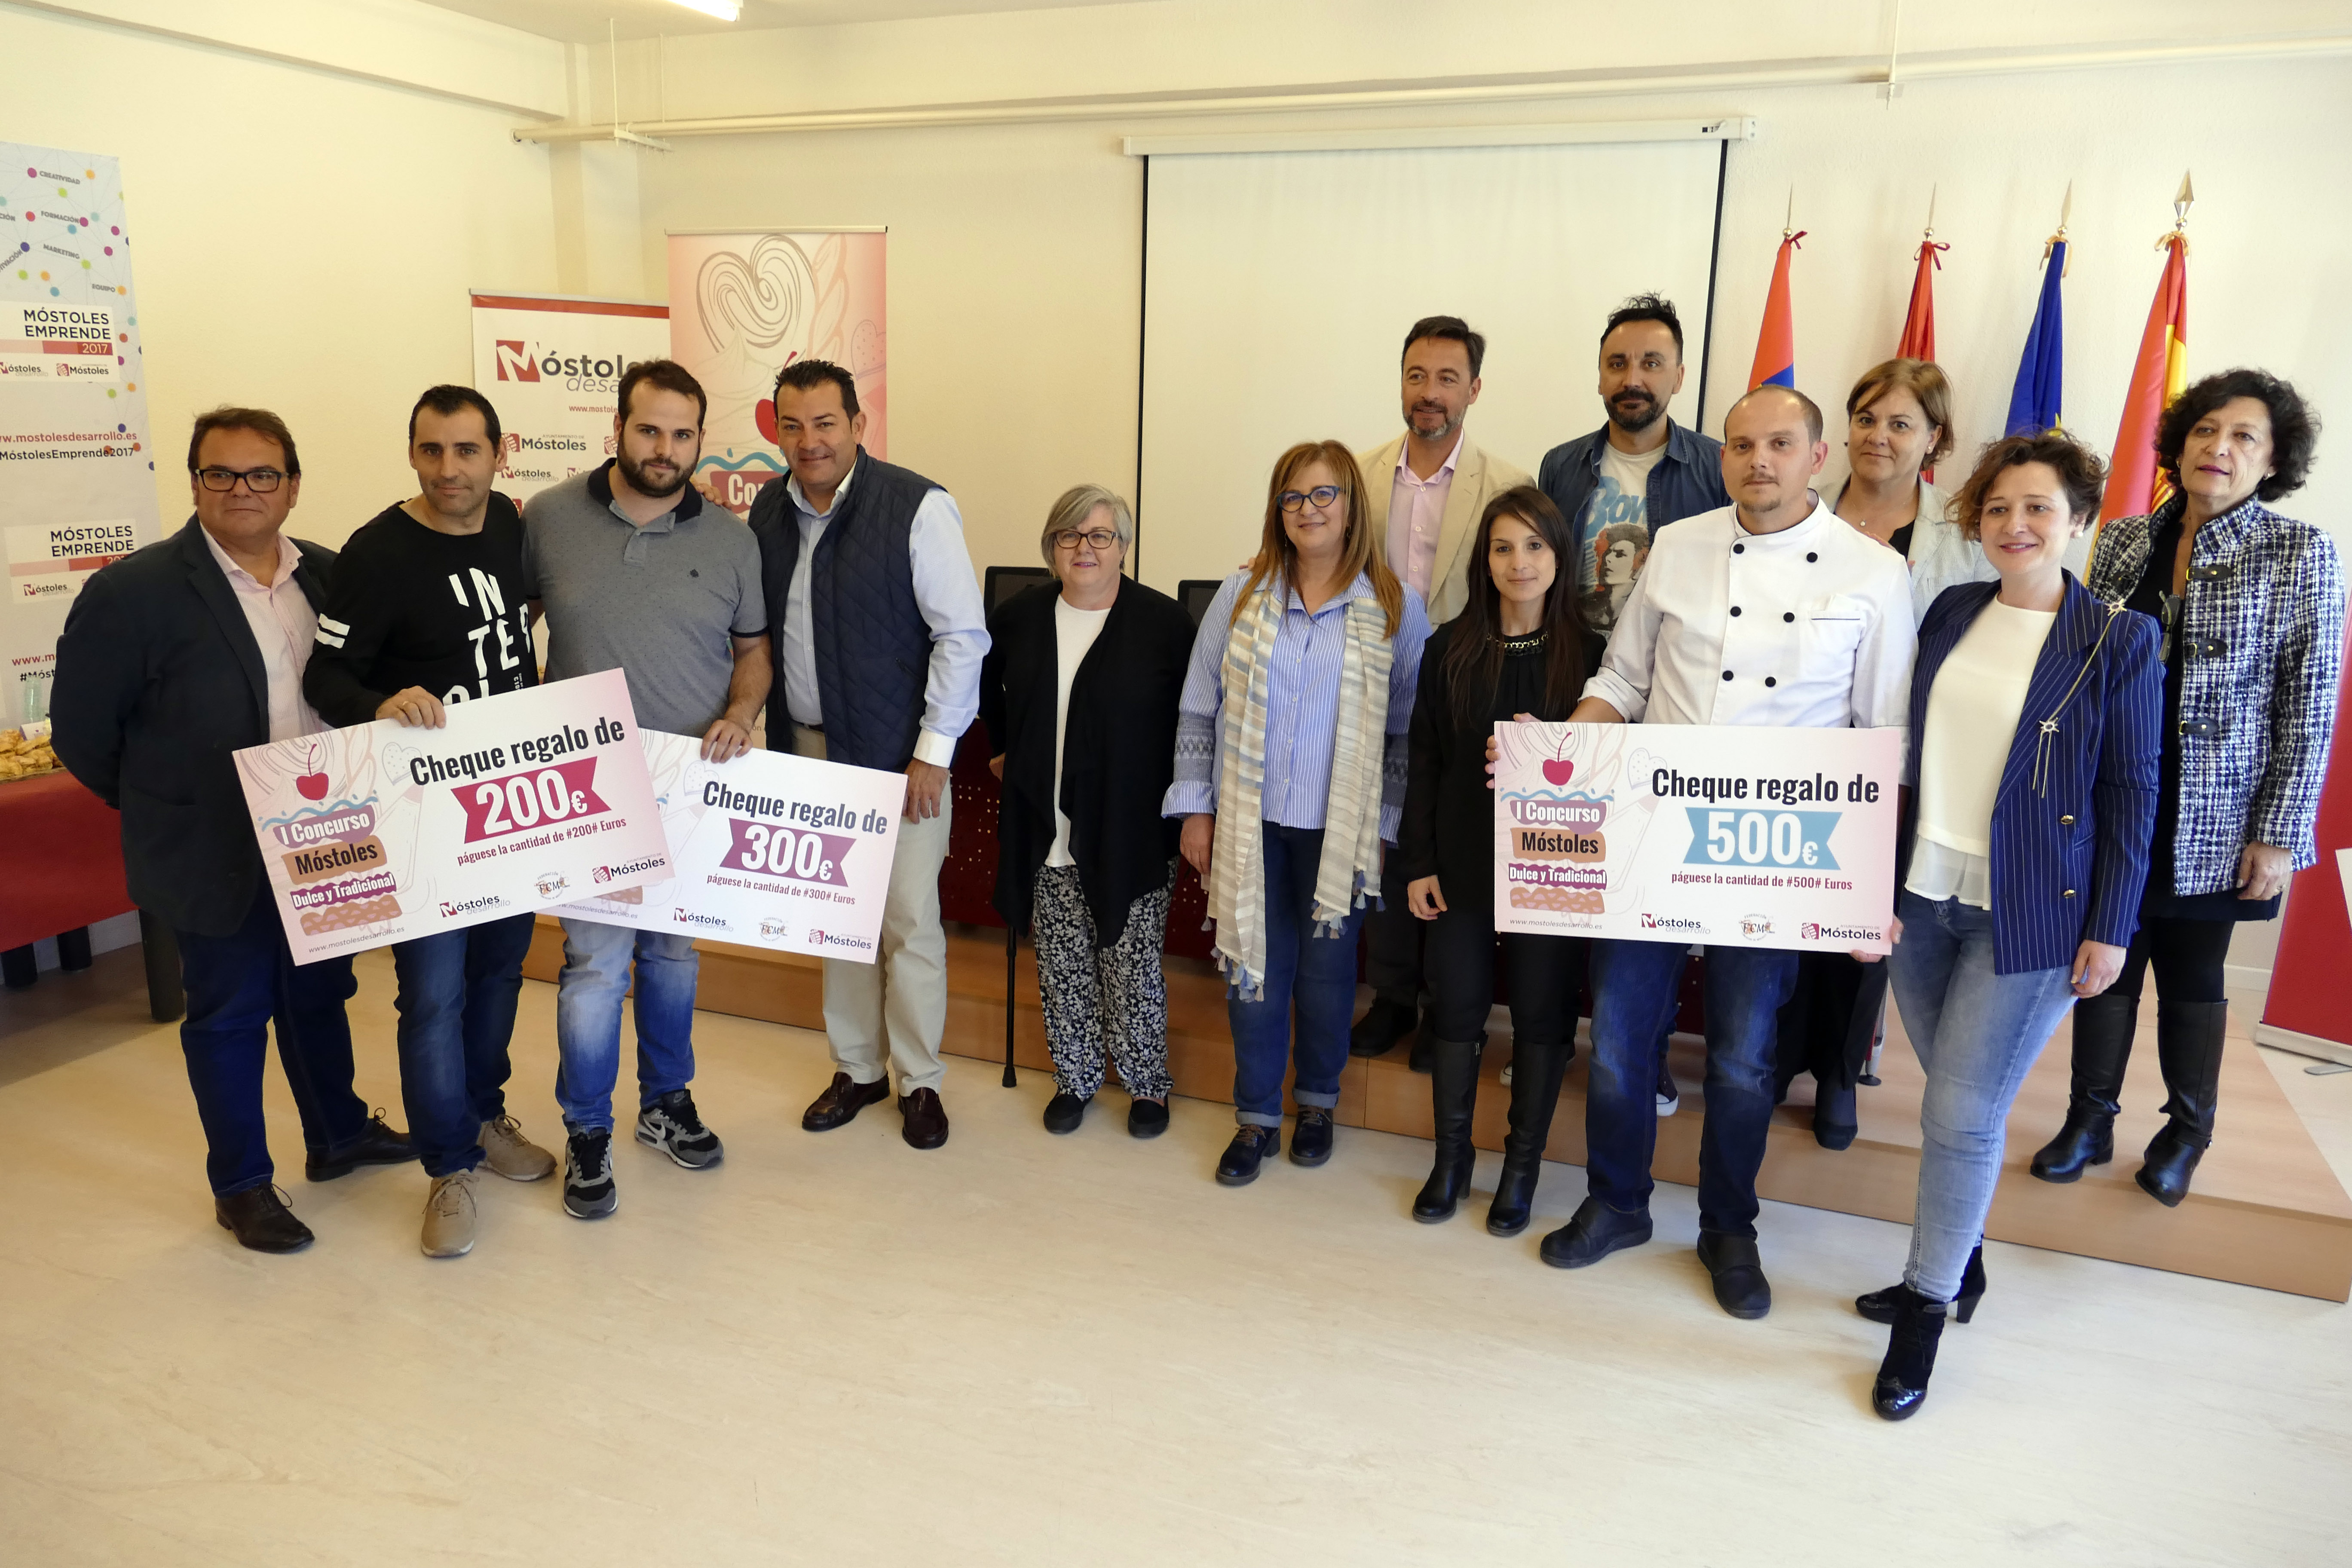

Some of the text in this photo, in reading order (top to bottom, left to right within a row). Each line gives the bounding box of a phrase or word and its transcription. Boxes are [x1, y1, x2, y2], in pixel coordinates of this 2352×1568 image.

[40, 171, 80, 184] CREATIVIDAD
[41, 211, 79, 224] FORMACIÓN
[43, 243, 80, 259] MARKETING
[92, 284, 116, 292] EQUIPO
[24, 307, 109, 324] MÓSTOLES
[25, 325, 111, 340] EMPRENDE
[82, 343, 107, 354] 2017
[496, 340, 641, 382] Móstol
[70, 366, 109, 374] Móstoles
[566, 373, 619, 393] desa
[569, 405, 618, 413] www.mostole
[521, 438, 586, 450] Móstoles
[50, 526, 132, 542] MÓSTOLES
[52, 540, 134, 557] EMPRENDE
[449, 567, 505, 621] IN
[12, 653, 55, 666] www.m
[410, 717, 625, 786] Cheque regalo de
[1652, 769, 1879, 805] Cheque regalo de
[476, 769, 587, 835] 200€
[703, 781, 888, 835] Cheque regalo de
[1516, 801, 1600, 823] I Concurso
[280, 813, 370, 845] I Concurso
[457, 818, 627, 866] páguese la cantidad de #200# Euros
[1522, 832, 1599, 854] Móstoles
[1707, 811, 1819, 866] 500€
[295, 843, 378, 875] Móstoles
[741, 824, 833, 881] 300€
[610, 858, 665, 877] Móstoles
[1509, 867, 1606, 884] Dulce y Tradicional
[707, 873, 855, 905] páguese la cantidad de #300# Euros
[1672, 871, 1853, 890] páguese la cantidad de #500# Euros
[292, 873, 395, 907] Dulce y Tradicional
[466, 900, 511, 915] desarrollo
[556, 903, 638, 919] w.mostolesdesarrollo.es
[694, 921, 734, 932] desarrollo
[1510, 919, 1603, 930] www.mostolesdesarrollo.es
[1665, 925, 1711, 934] desarrollo
[309, 926, 405, 953] www.mostolesdesarrollo.es
[824, 934, 872, 949] Móstoles
[1821, 927, 1881, 940] Móstoles
